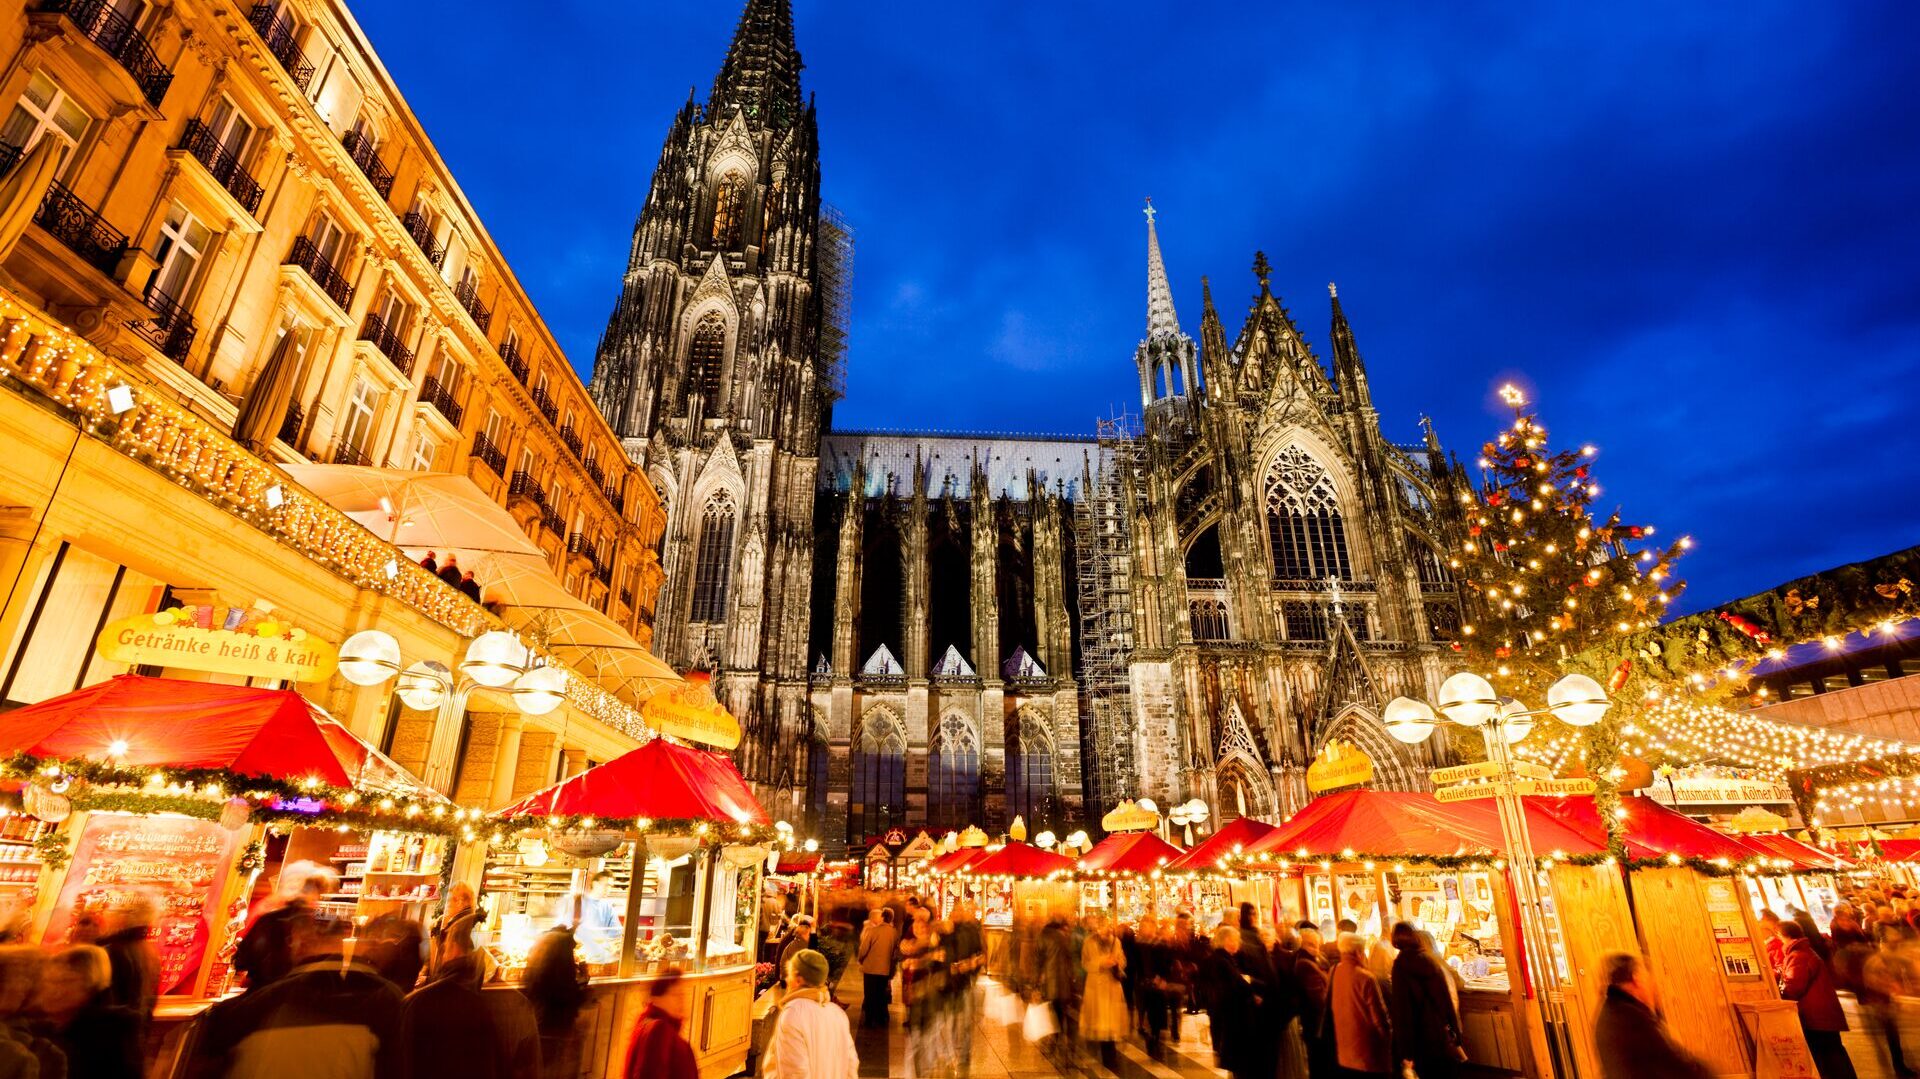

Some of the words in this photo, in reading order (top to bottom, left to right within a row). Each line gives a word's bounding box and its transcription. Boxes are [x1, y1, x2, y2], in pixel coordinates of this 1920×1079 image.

[118, 629, 210, 654] Getränke
[218, 641, 259, 659] heiß
[266, 647, 278, 662] &
[285, 650, 320, 667] kalt
[649, 703, 711, 731] Selbstgemachte
[1436, 768, 1480, 781] Toilette
[1440, 787, 1497, 800] Anlieferung
[1534, 781, 1590, 794] Altstadt
[1725, 789, 1740, 801] am
[1741, 785, 1772, 800] Kölner
